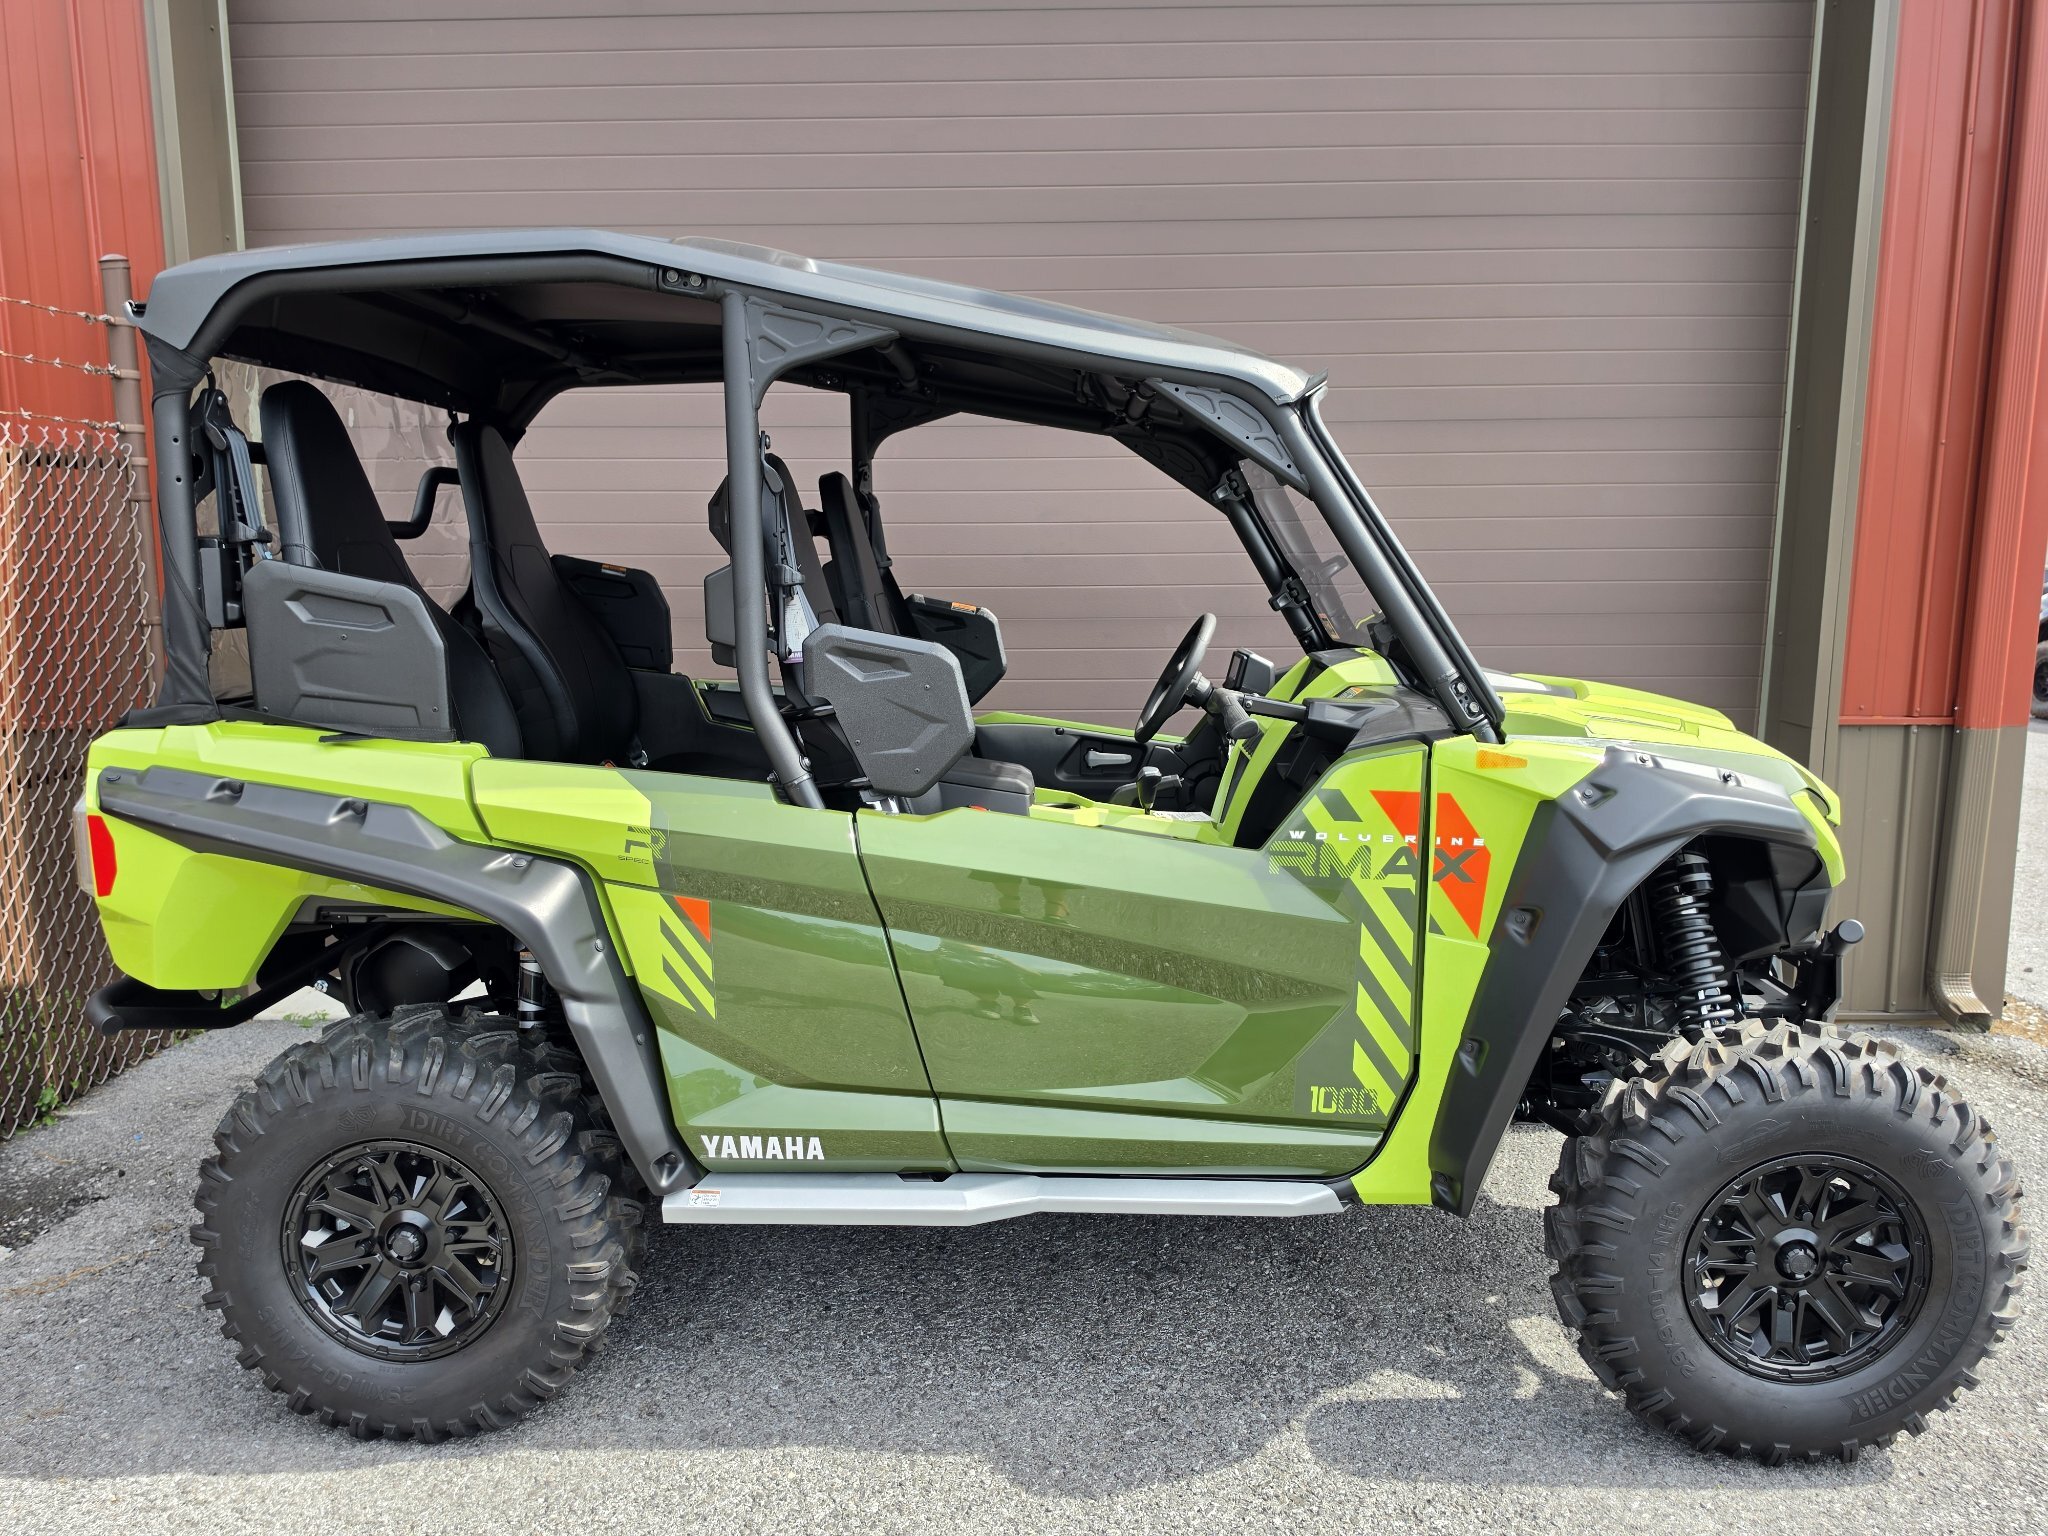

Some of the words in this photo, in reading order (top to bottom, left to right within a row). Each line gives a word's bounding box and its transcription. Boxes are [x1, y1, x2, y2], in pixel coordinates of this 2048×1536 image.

[617, 855, 650, 865] SPEC
[624, 825, 667, 861] R
[1268, 840, 1479, 884] RMAX
[1310, 1085, 1378, 1115] 1000
[700, 1134, 825, 1160] YAMAHA
[409, 1109, 472, 1148] DIRT
[473, 1141, 550, 1309] COMMANDER
[1949, 1205, 1981, 1264] DIRT
[1854, 1271, 1982, 1419] COMMANDER
